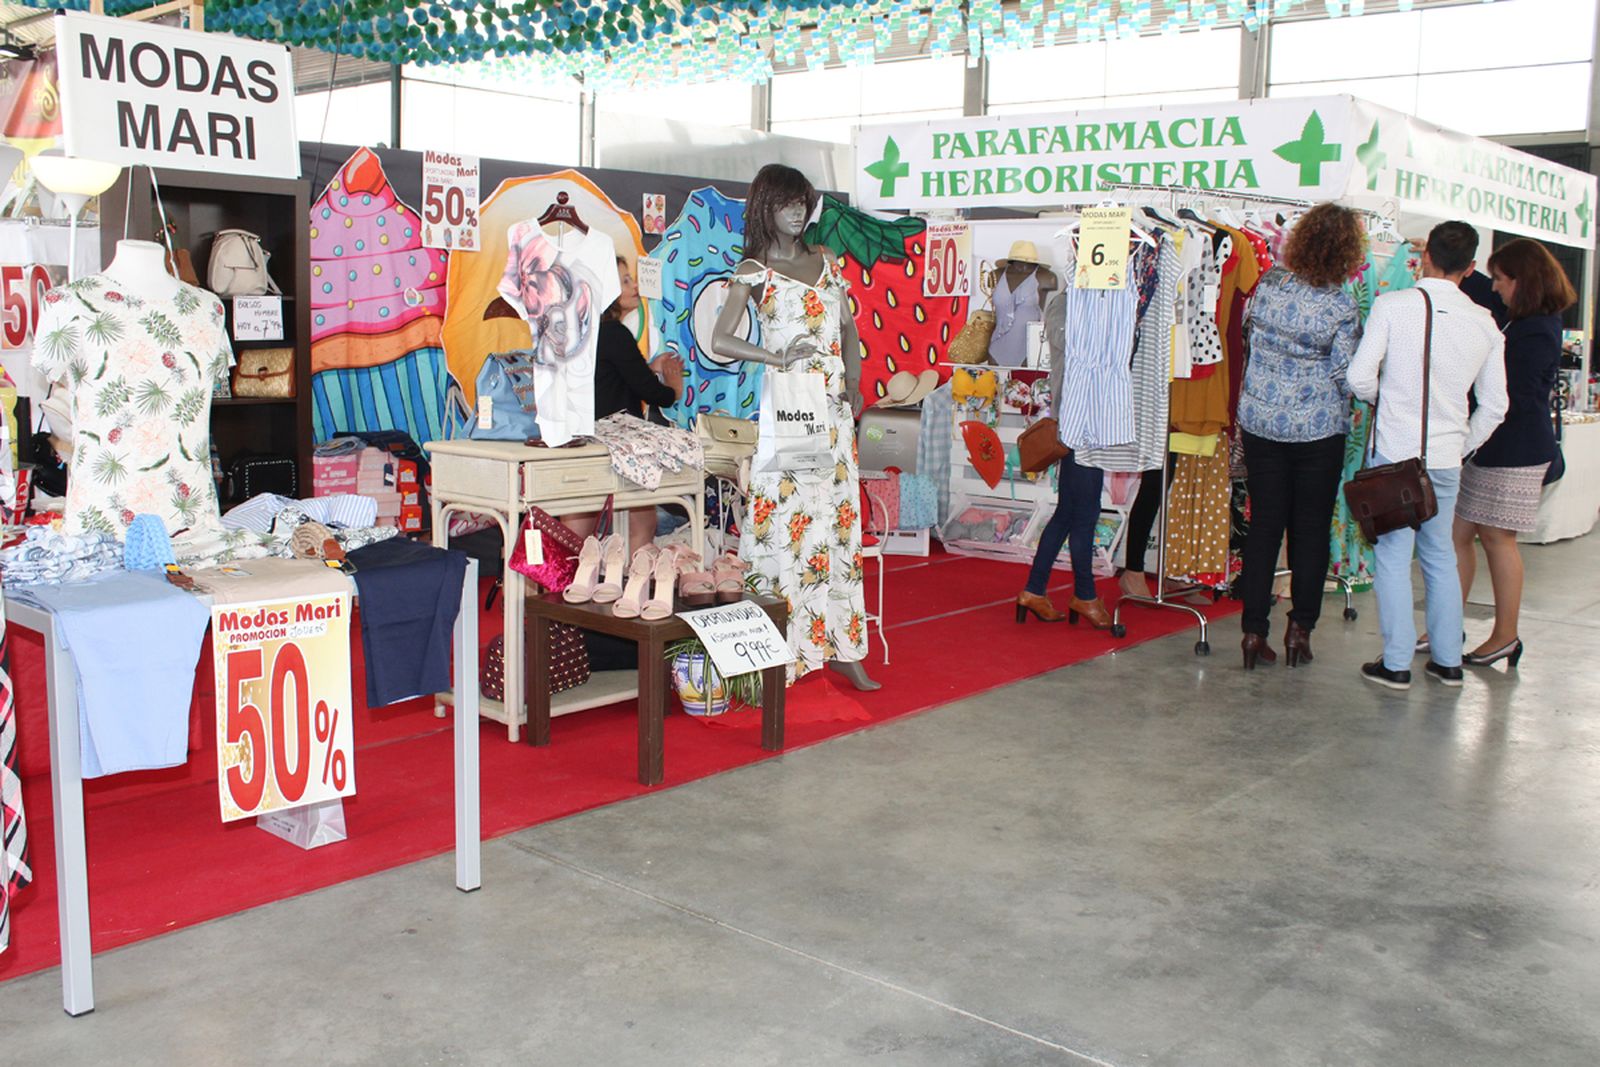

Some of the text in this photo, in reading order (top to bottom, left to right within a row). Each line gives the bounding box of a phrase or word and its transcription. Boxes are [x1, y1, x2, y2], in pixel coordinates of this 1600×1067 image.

[79, 33, 279, 104] MODAS
[117, 100, 257, 161] MARI
[932, 116, 1248, 160] PARAFARMACIA
[425, 150, 462, 166] Modas
[456, 165, 478, 178] Mari
[920, 158, 1260, 198] HERBORISTERIA
[1405, 130, 1568, 201] AFARMACIA
[425, 184, 478, 228] 50%
[927, 238, 969, 295] 50%
[776, 409, 815, 422] Modas
[804, 421, 826, 436] Mari
[219, 598, 341, 632] Modas Mari
[230, 627, 287, 644] PROMOCION
[226, 642, 347, 812] 50%
